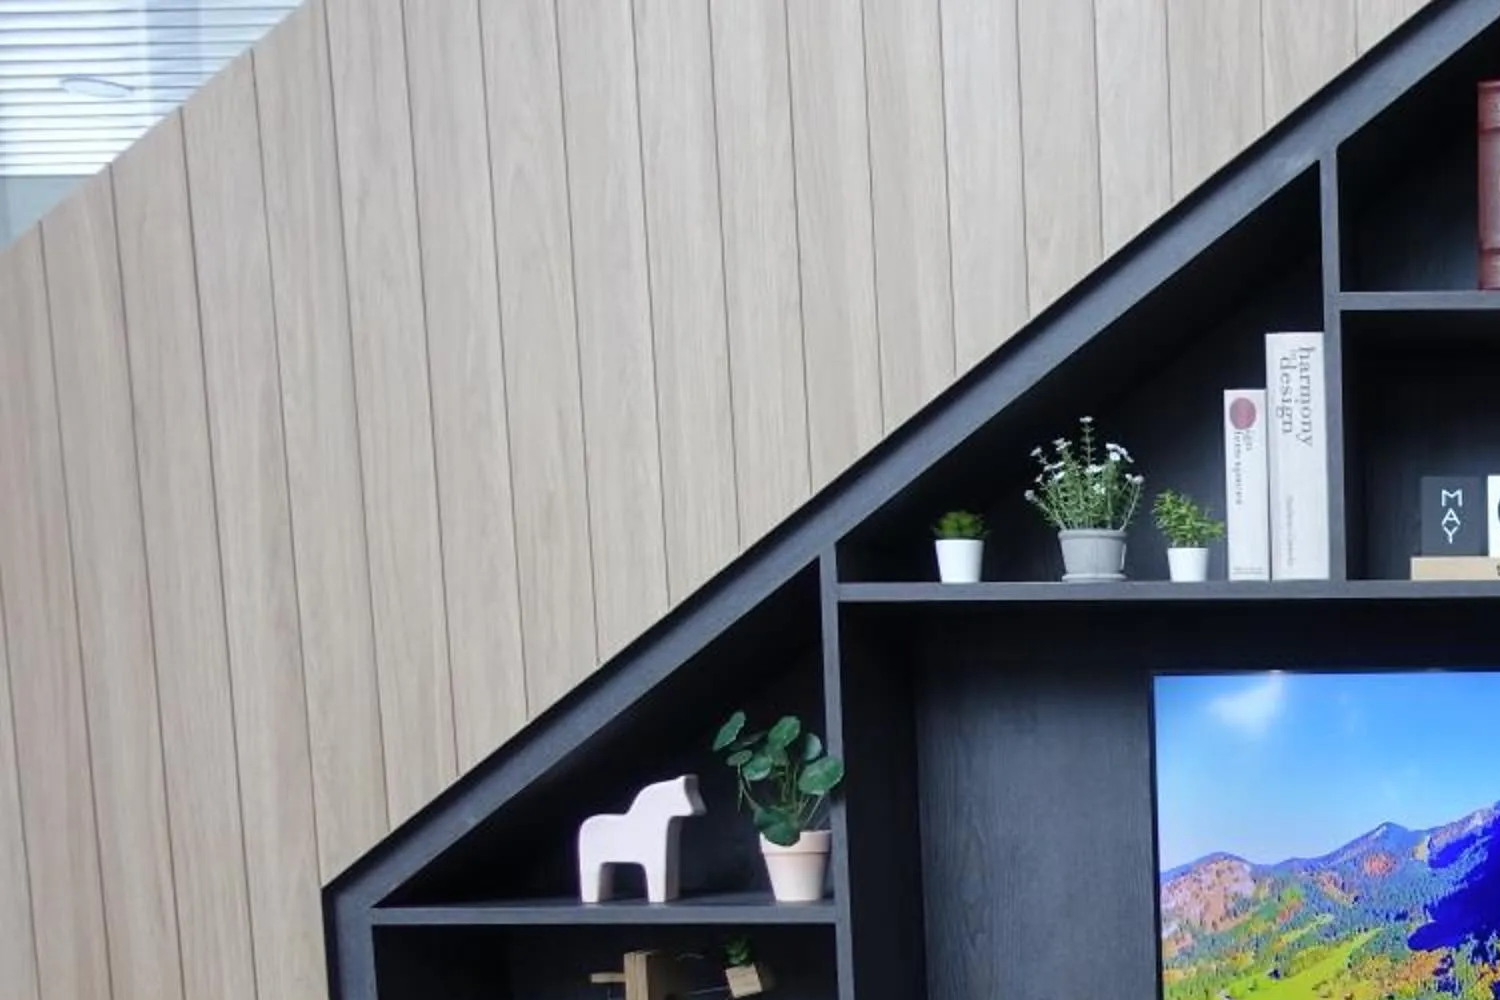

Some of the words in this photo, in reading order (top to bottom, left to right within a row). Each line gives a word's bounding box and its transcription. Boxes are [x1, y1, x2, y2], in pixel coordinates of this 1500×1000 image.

[1276, 357, 1298, 435] design
[1297, 345, 1316, 448] harmony
[1441, 488, 1464, 544] MAY
